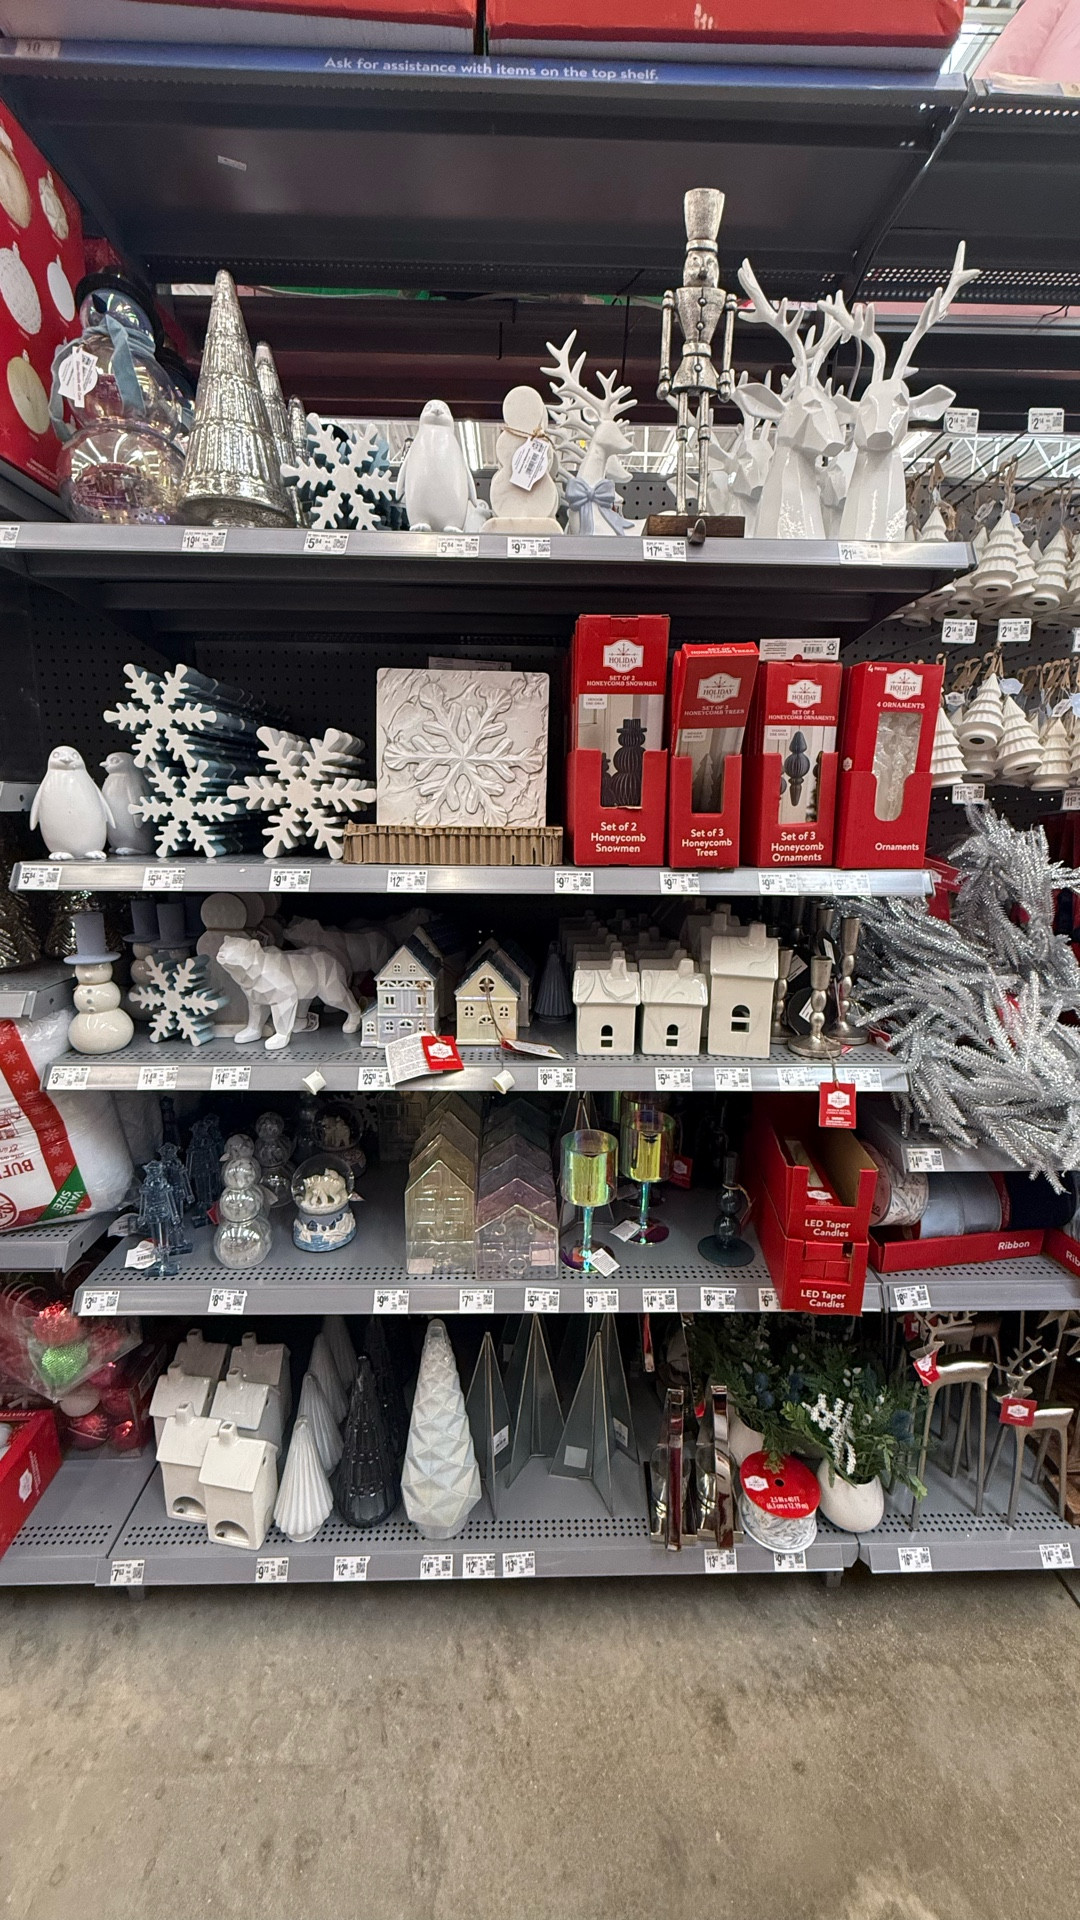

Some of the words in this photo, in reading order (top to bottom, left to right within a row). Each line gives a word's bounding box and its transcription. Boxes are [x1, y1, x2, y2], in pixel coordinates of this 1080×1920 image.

[324, 57, 352, 69] Ask
[356, 58, 379, 70] for
[382, 60, 456, 73] assistance
[460, 62, 492, 74] with
[496, 63, 536, 76] items
[540, 68, 559, 77] on
[563, 66, 587, 78] the
[592, 68, 616, 81] top
[620, 69, 659, 80] shelf.
[867, 664, 874, 672] 4
[600, 822, 616, 832] Set
[618, 822, 629, 832] of
[631, 822, 637, 832] 2
[590, 832, 646, 844] Honeycomb
[690, 829, 705, 838] Set
[707, 828, 717, 837] of
[718, 828, 724, 836] 3
[781, 832, 796, 841] Set
[798, 832, 808, 841] of
[810, 832, 816, 840] 3
[682, 838, 732, 848] Honeycomb
[771, 842, 824, 853] Honeycomb
[874, 842, 920, 851] Ornaments
[596, 844, 640, 853] Snowmen
[696, 848, 718, 857] Trees
[772, 852, 822, 862] Ornaments
[804, 1219, 824, 1228] LED
[826, 1220, 851, 1230] Taper
[812, 1228, 849, 1238] Candles
[998, 1241, 1030, 1250] Ribbon
[800, 1289, 820, 1298] LED
[821, 1290, 846, 1300] Taper
[809, 1299, 845, 1308] Candles
